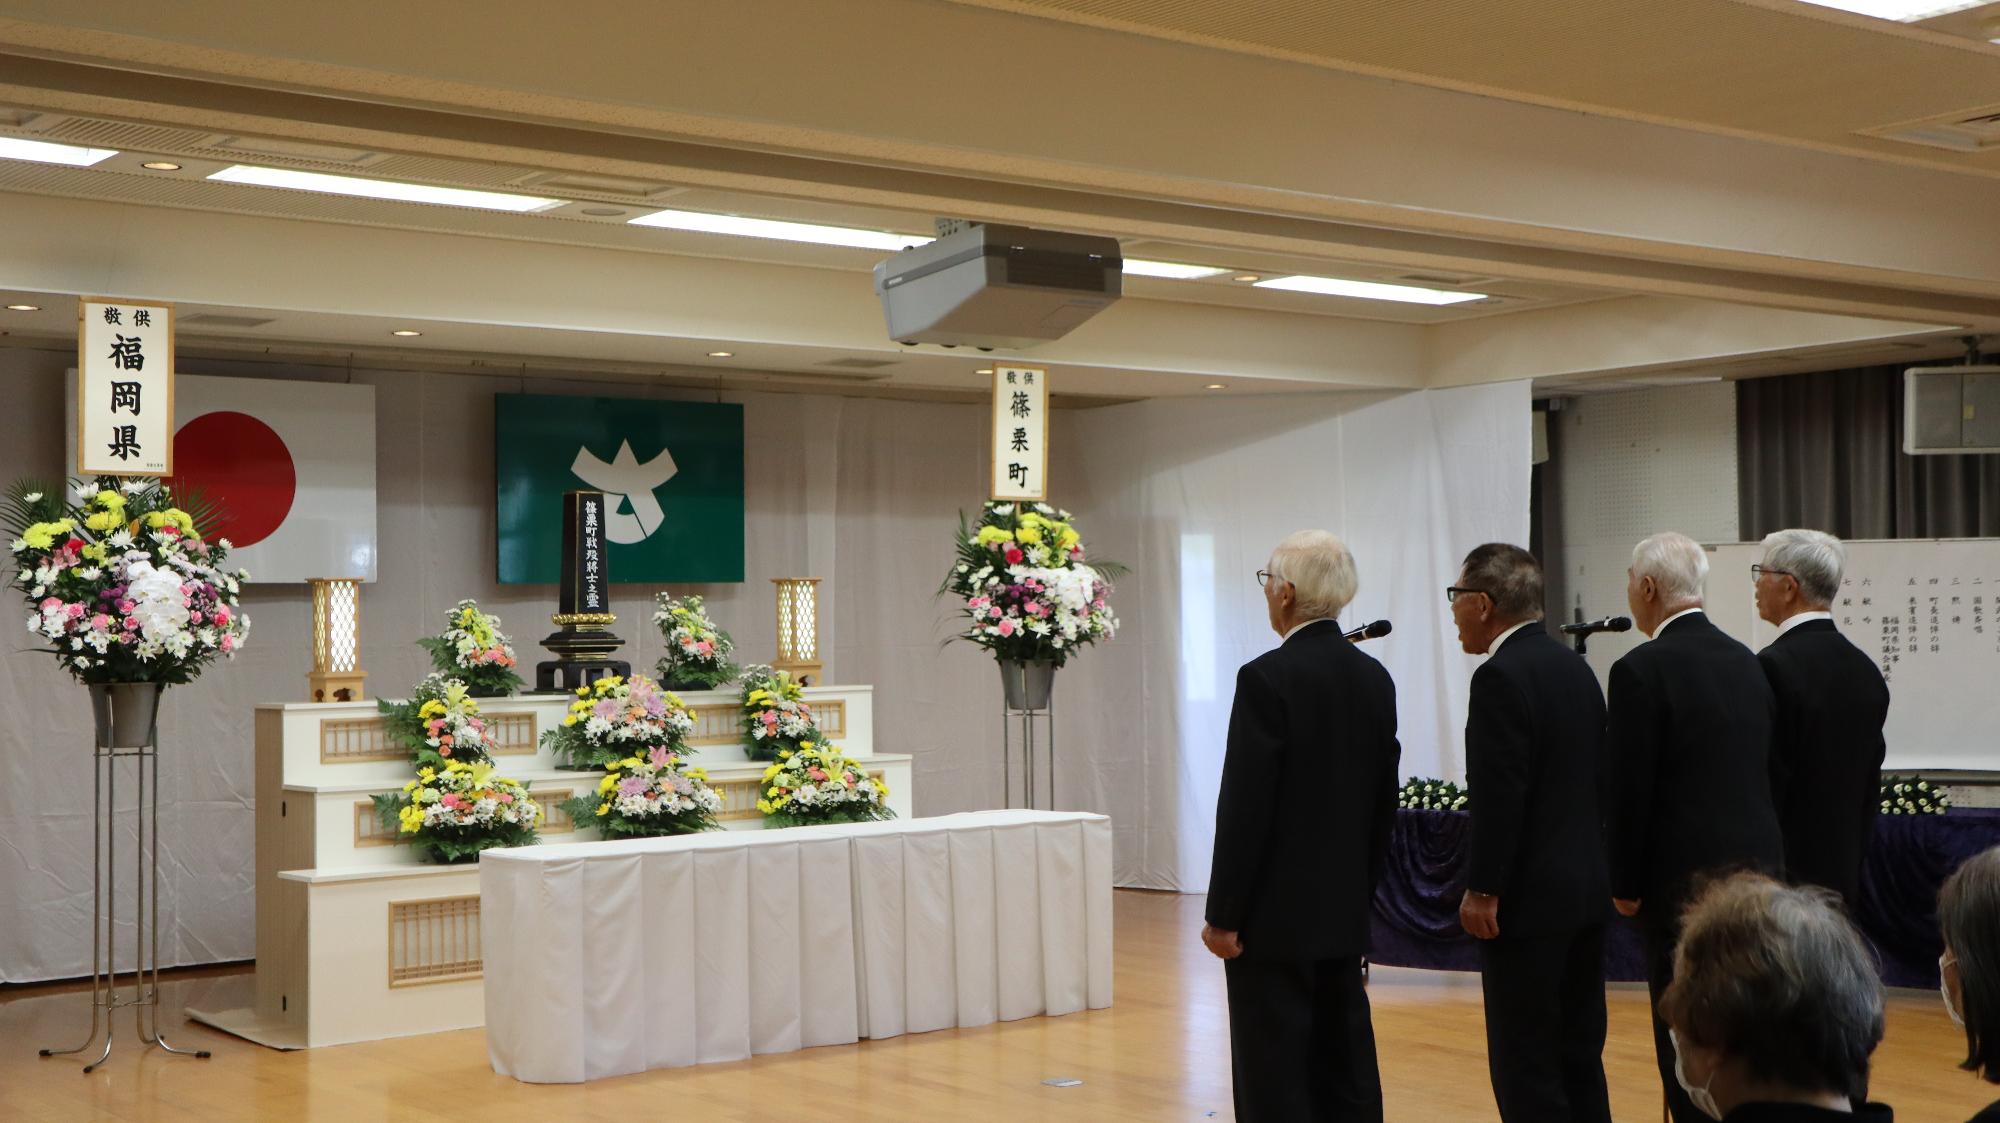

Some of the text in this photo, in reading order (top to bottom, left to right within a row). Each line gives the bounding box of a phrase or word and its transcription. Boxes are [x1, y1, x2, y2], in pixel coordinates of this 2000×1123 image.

[107, 333, 145, 461] 福岡県
[1008, 390, 1031, 488] 篠栗町
